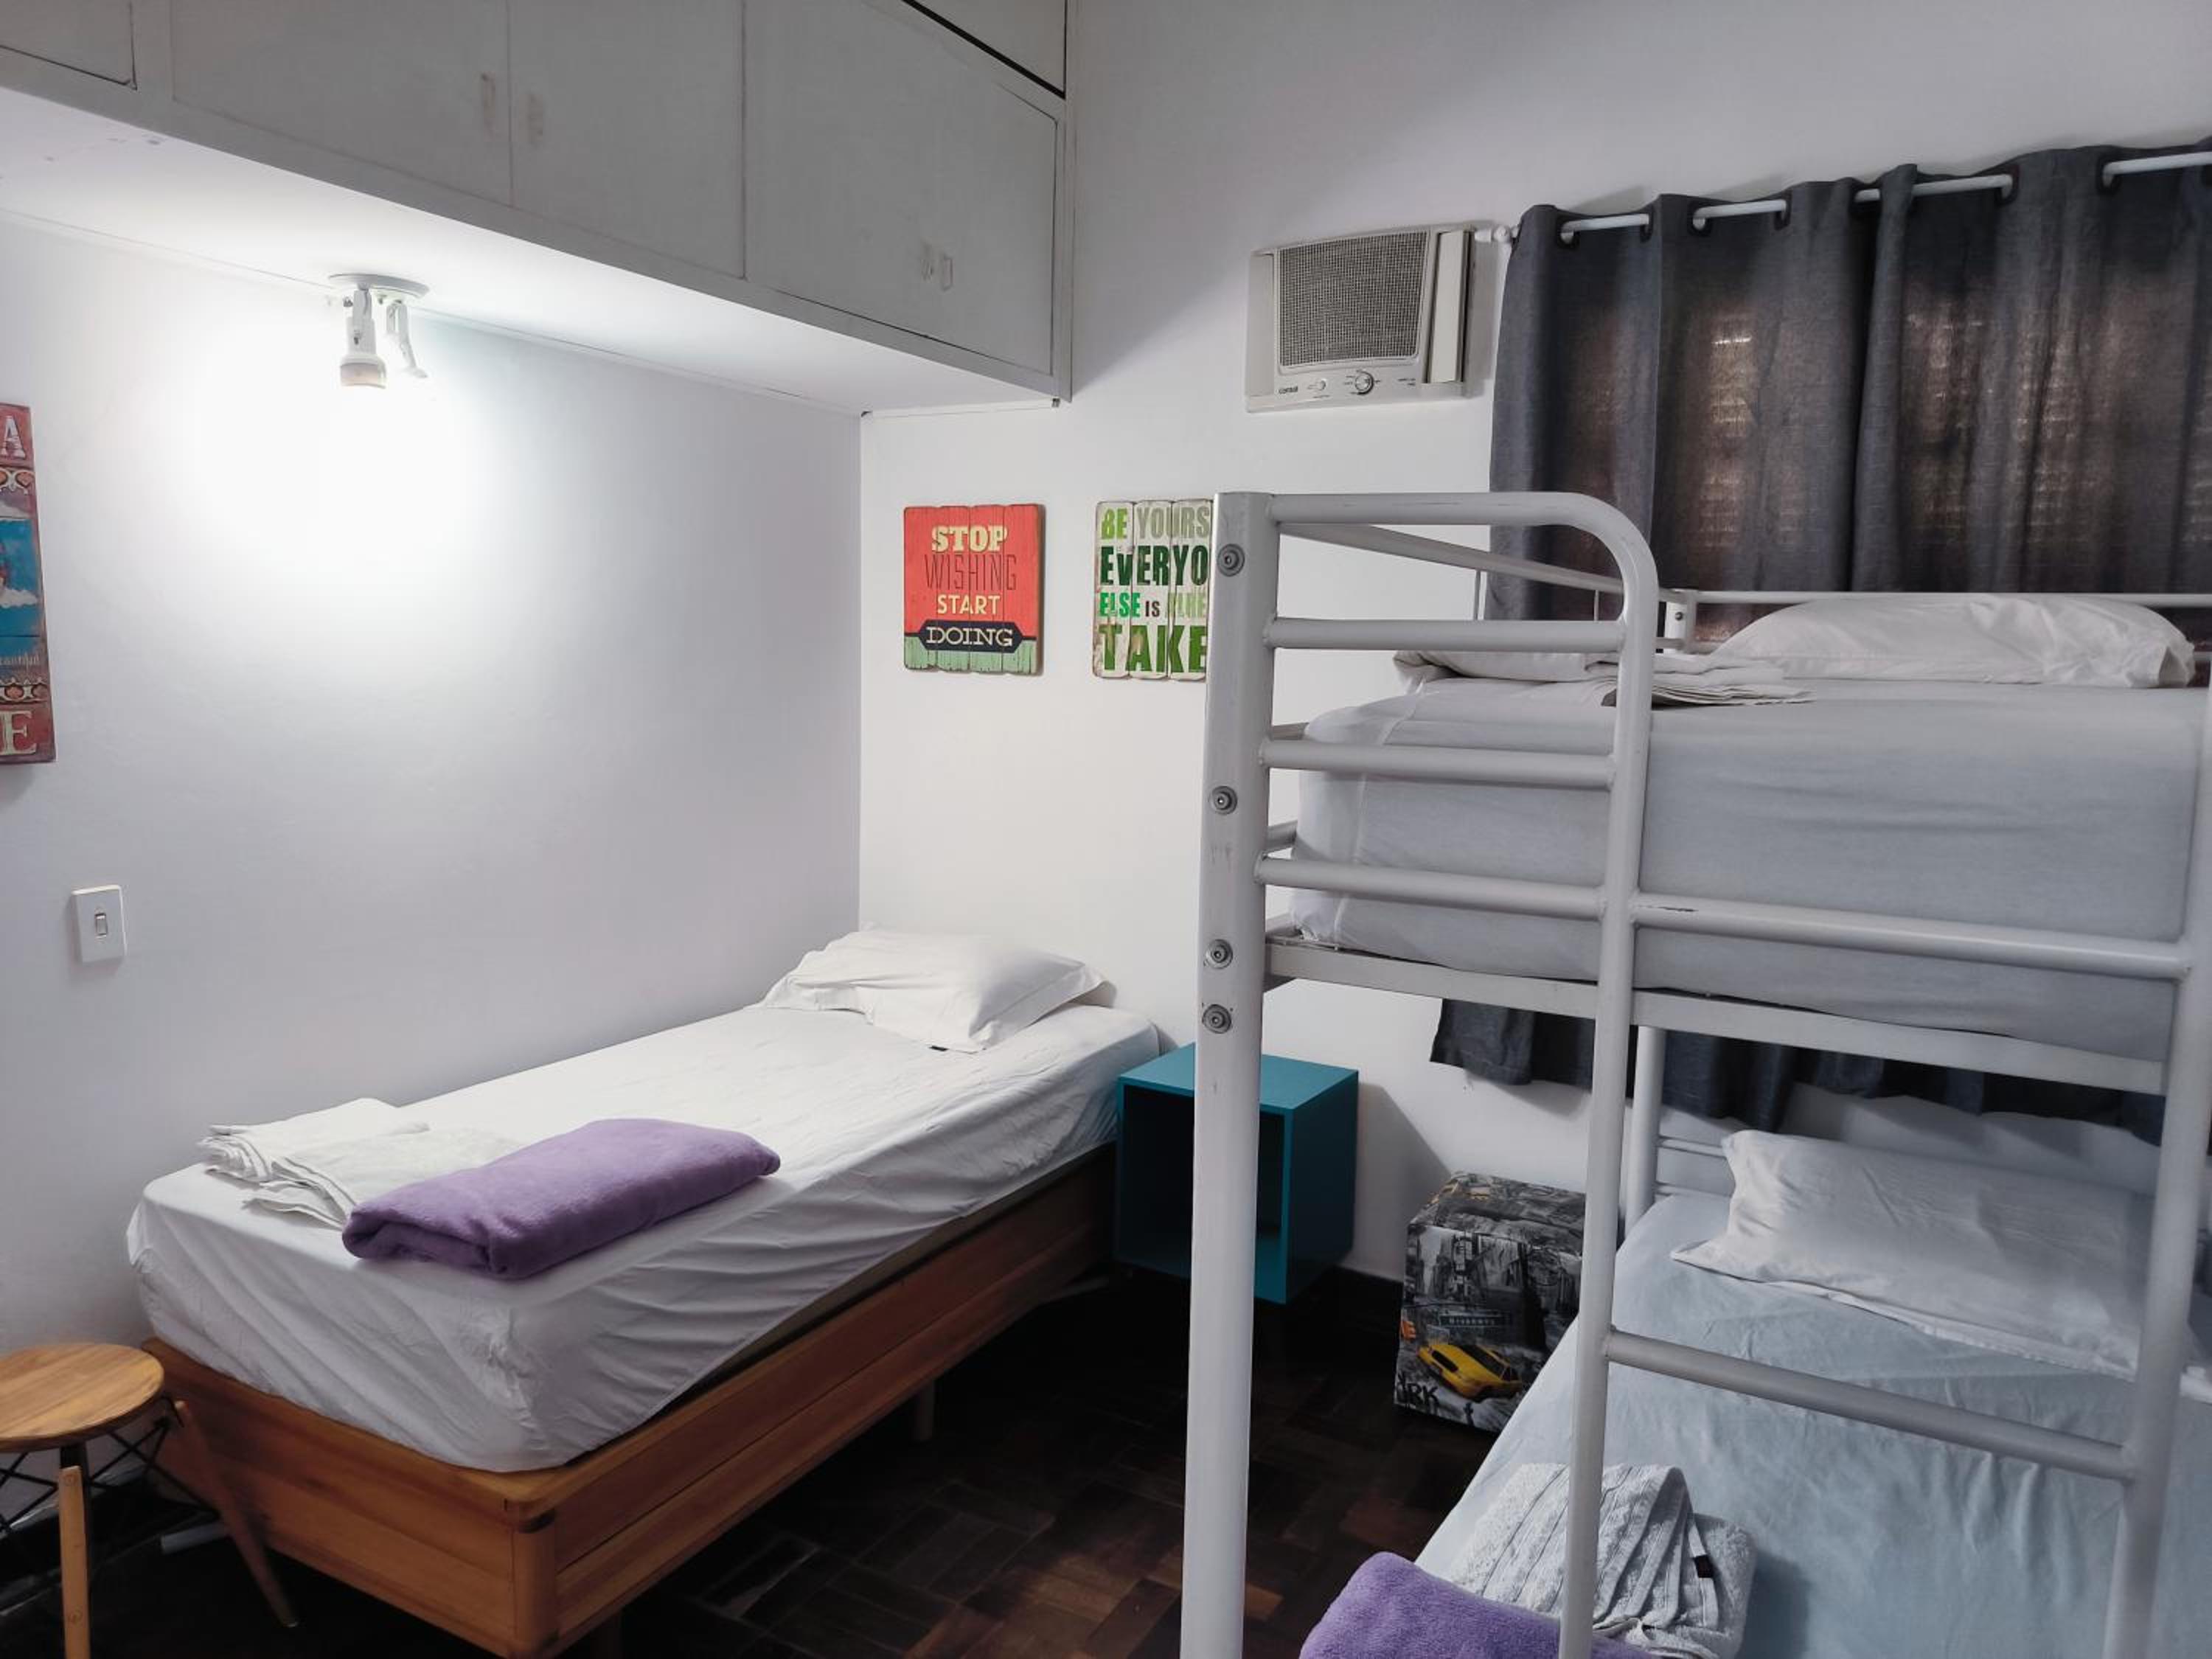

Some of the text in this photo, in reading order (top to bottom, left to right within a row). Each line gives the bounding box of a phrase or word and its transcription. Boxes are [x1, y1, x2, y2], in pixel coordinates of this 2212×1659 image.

[931, 524, 1008, 552] STOP
[1102, 507, 1209, 540] BE YOURS
[924, 554, 1017, 591] WISHING
[1101, 545, 1208, 586] EVERYO
[937, 594, 1001, 614] START
[1099, 592, 1141, 617] ELSE
[1145, 601, 1160, 617] IS
[925, 627, 1013, 647] DOING
[1099, 625, 1207, 672] TAKE
